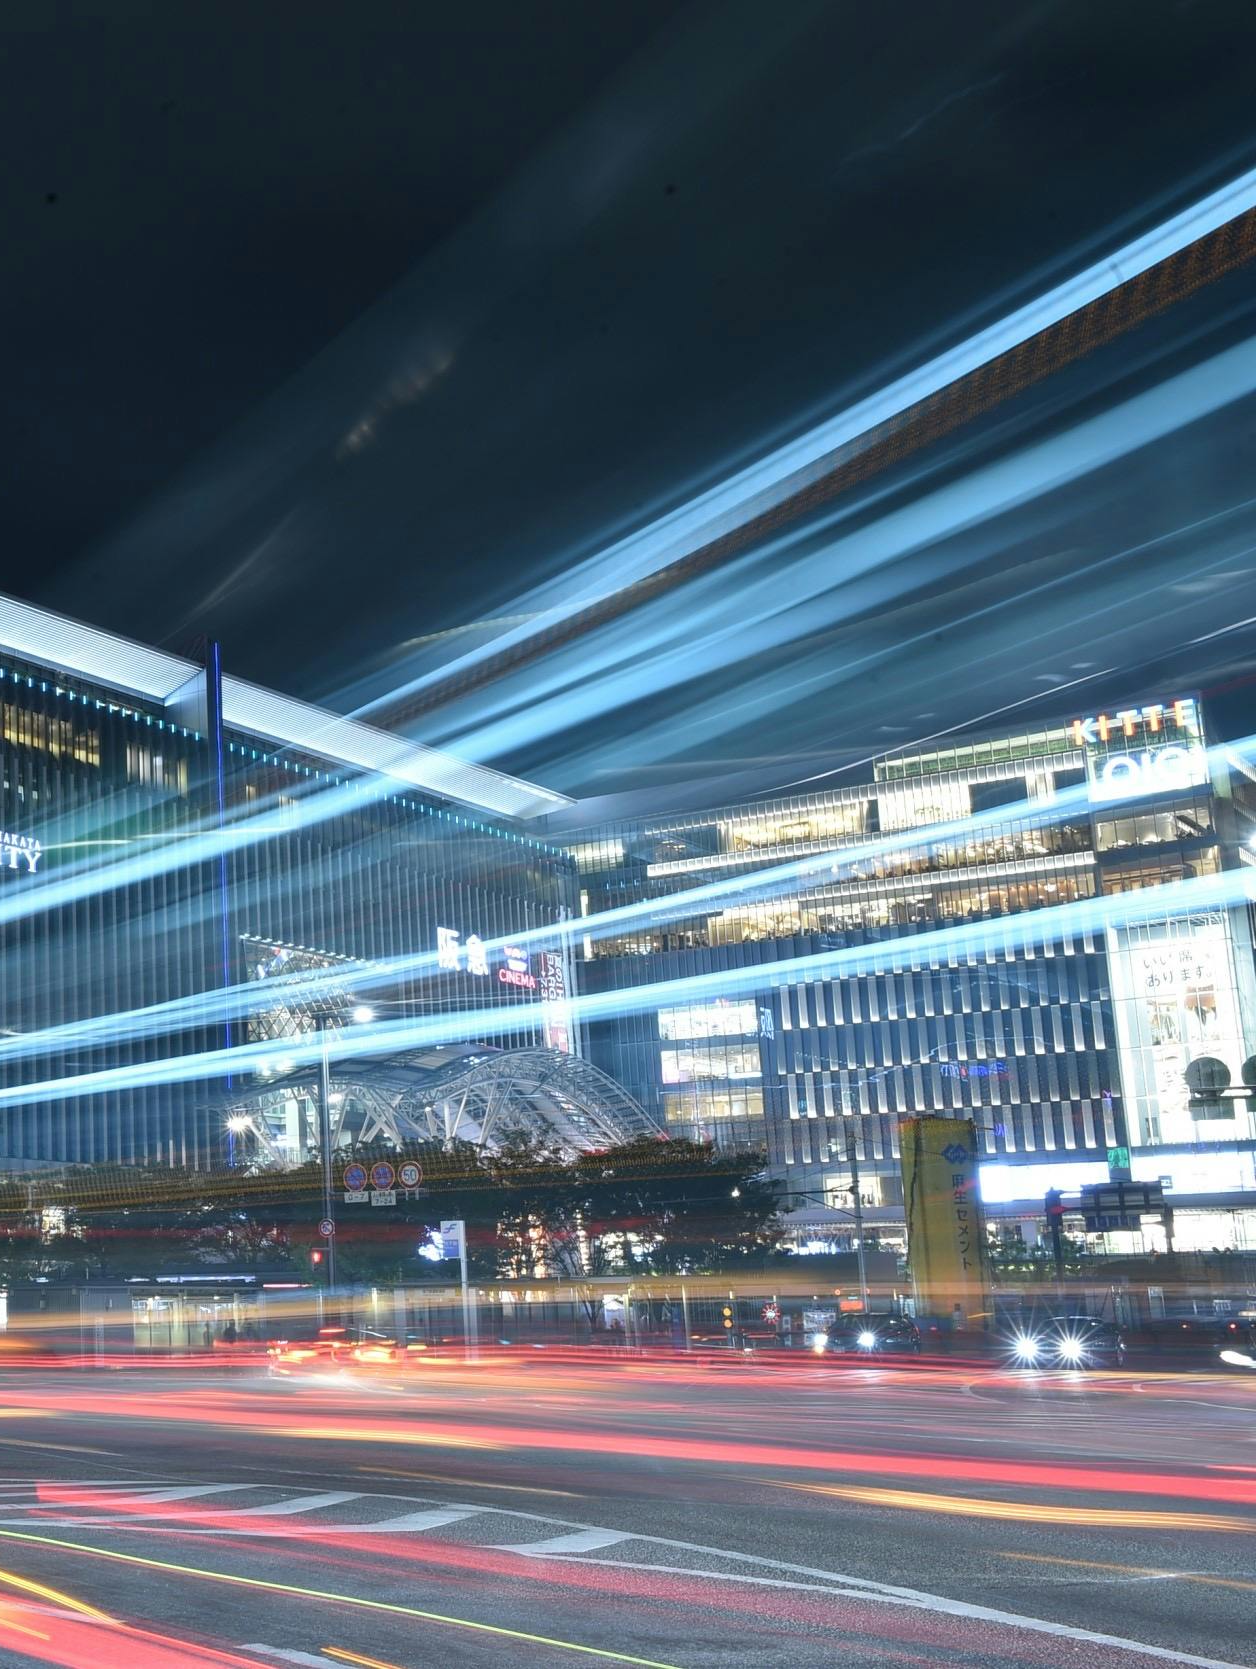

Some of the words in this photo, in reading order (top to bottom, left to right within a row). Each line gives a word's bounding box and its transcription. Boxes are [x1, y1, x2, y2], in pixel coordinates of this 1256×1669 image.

[1073, 698, 1197, 746] KITTE
[498, 968, 536, 989] CINEMA
[403, 1169, 417, 1181] 50
